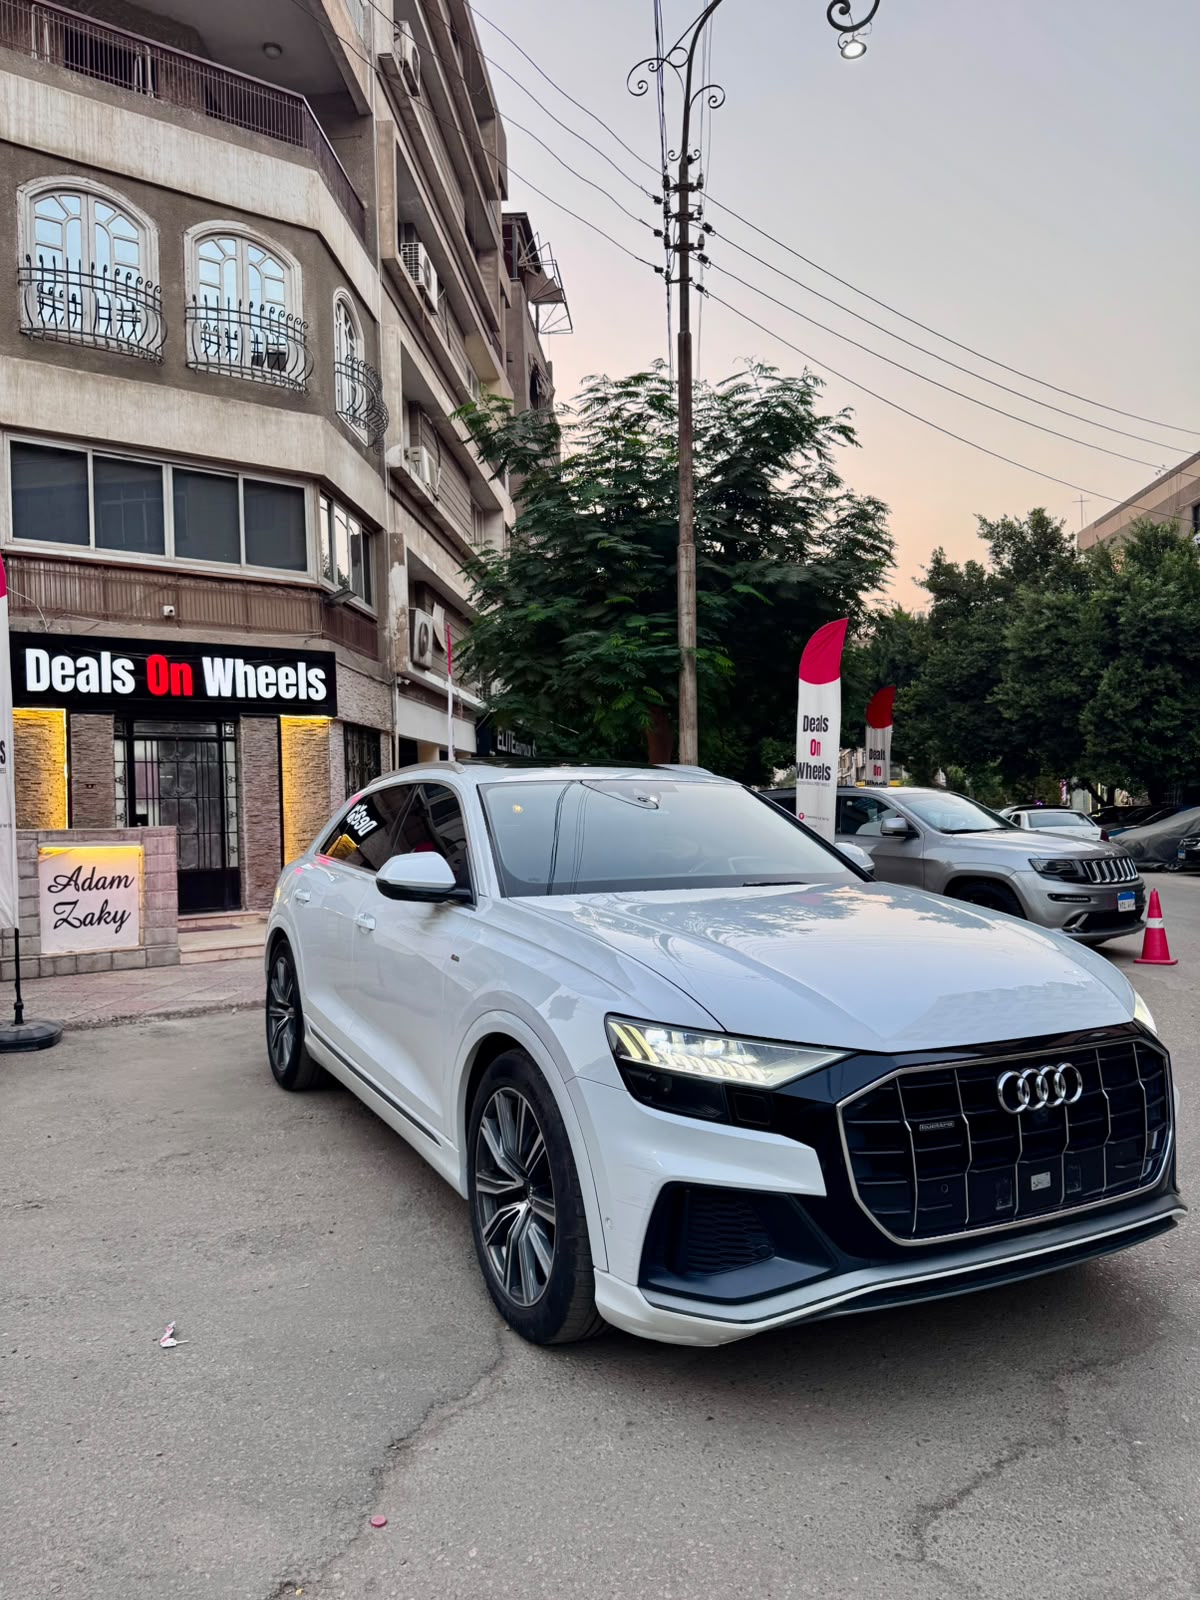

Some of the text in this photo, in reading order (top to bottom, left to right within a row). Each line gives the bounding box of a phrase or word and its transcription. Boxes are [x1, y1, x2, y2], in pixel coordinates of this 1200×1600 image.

[25, 648, 327, 701] Deals On Wheels
[803, 715, 829, 732] Deals
[810, 739, 821, 756] On
[869, 748, 886, 761] Deals
[796, 762, 831, 781] Wheels
[873, 765, 881, 776] On
[47, 865, 135, 894] Adam
[52, 898, 132, 935] Zaky
